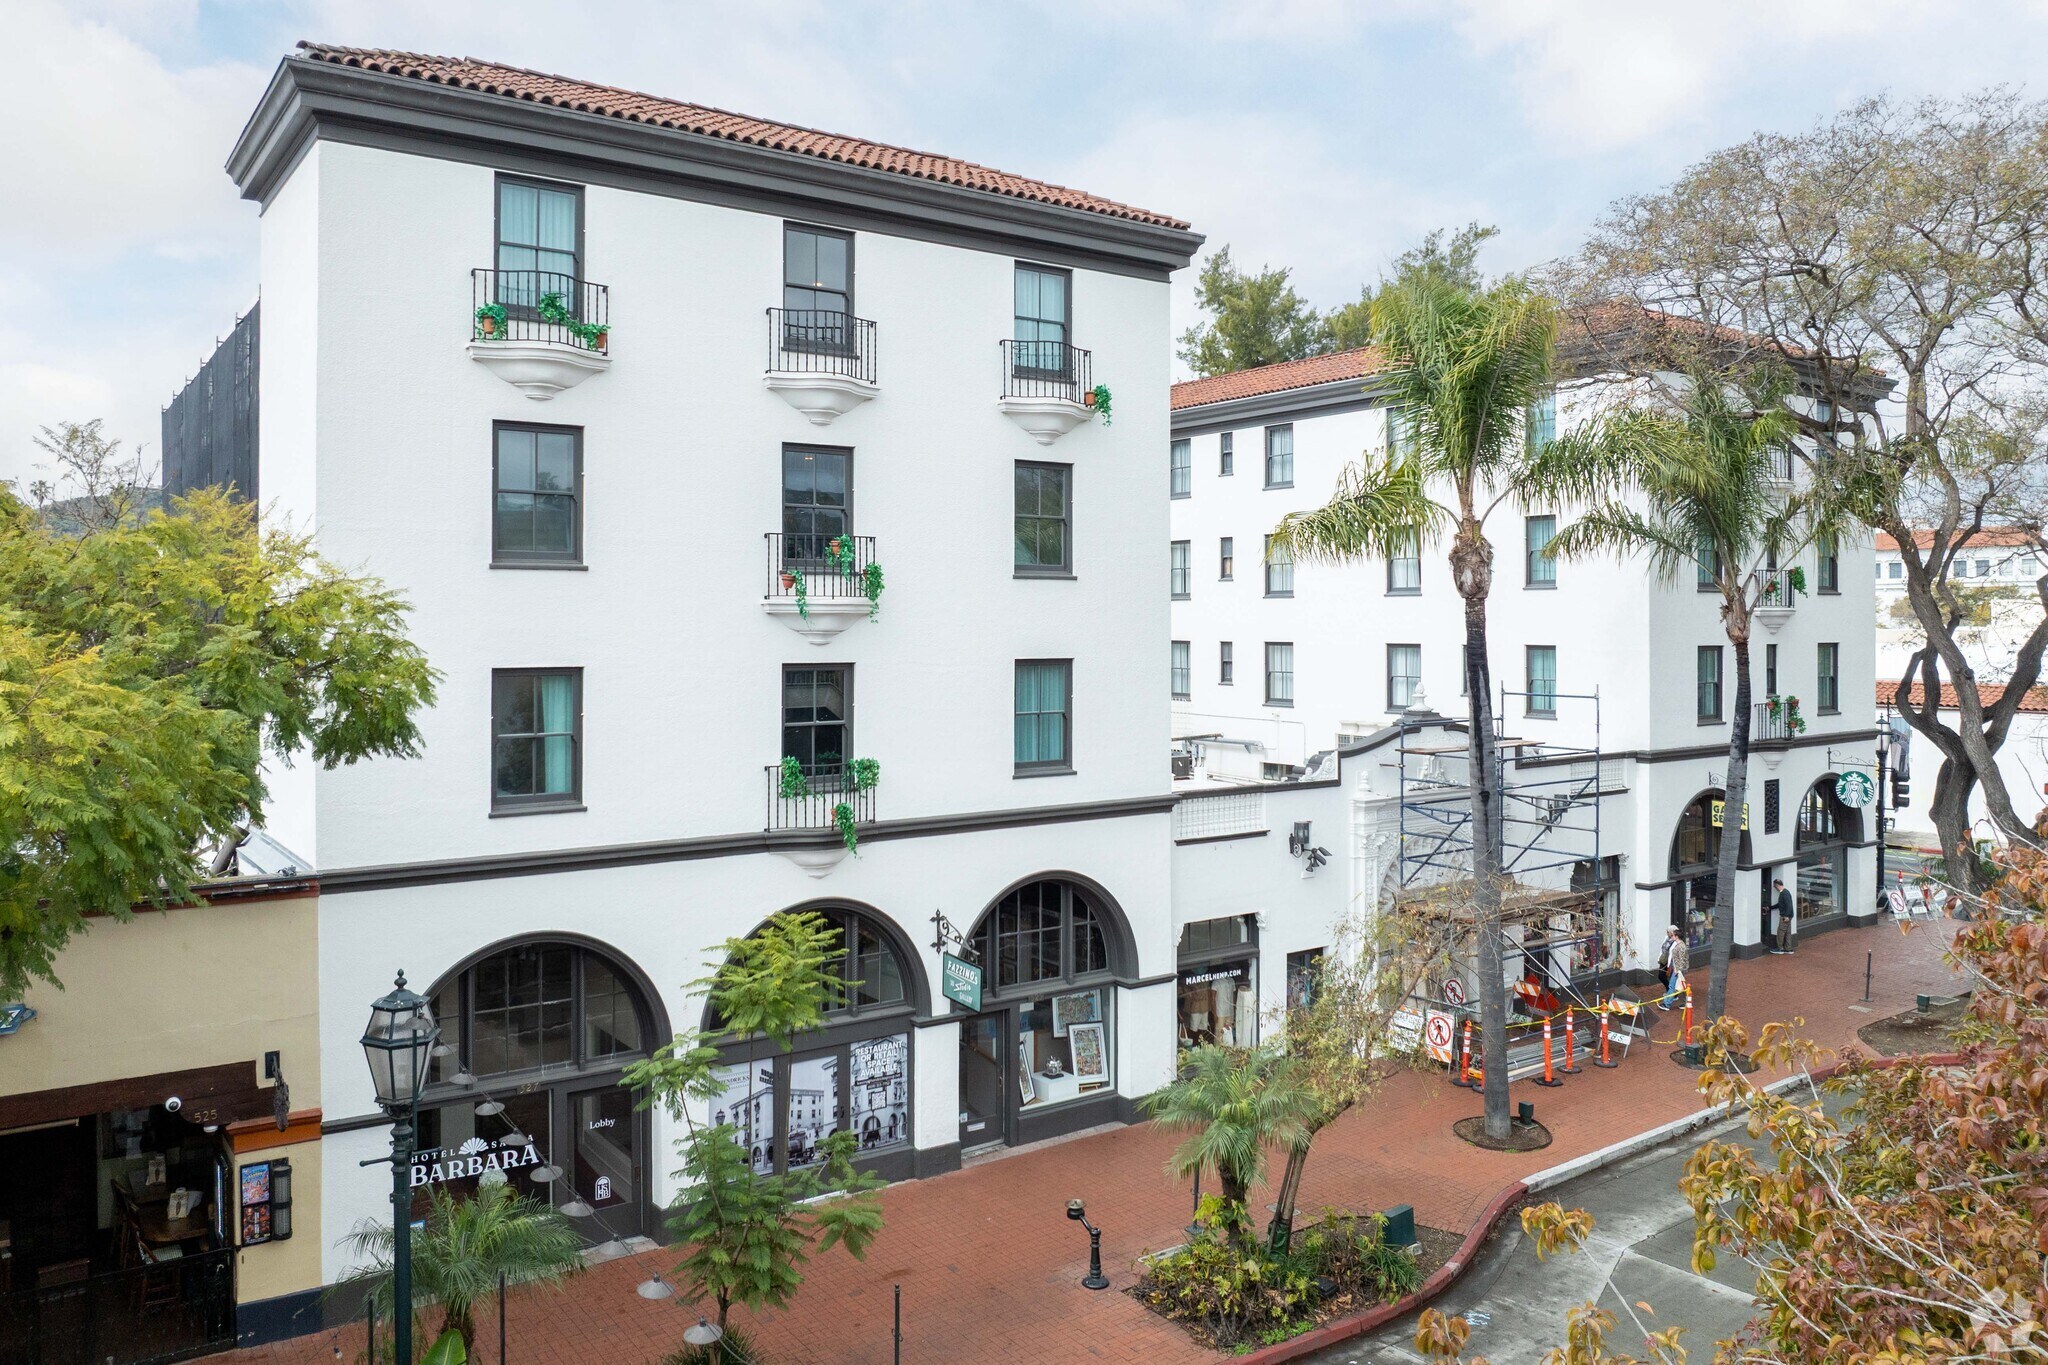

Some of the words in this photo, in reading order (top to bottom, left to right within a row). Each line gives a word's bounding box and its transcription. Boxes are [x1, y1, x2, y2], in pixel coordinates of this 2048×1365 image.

[1185, 968, 1242, 985] MARCELHEMP.COM
[855, 1040, 903, 1056] RESTAURANT
[861, 1054, 872, 1062] OR
[874, 1049, 898, 1060] RETAIL
[861, 1063, 897, 1077] AVAILABLE
[867, 1058, 891, 1068] SPACE
[520, 1081, 539, 1094] 527
[194, 1109, 218, 1123] 525
[589, 1118, 616, 1130] Lobby
[411, 1148, 456, 1164] HOTEL
[410, 1144, 540, 1187] BARBARA
